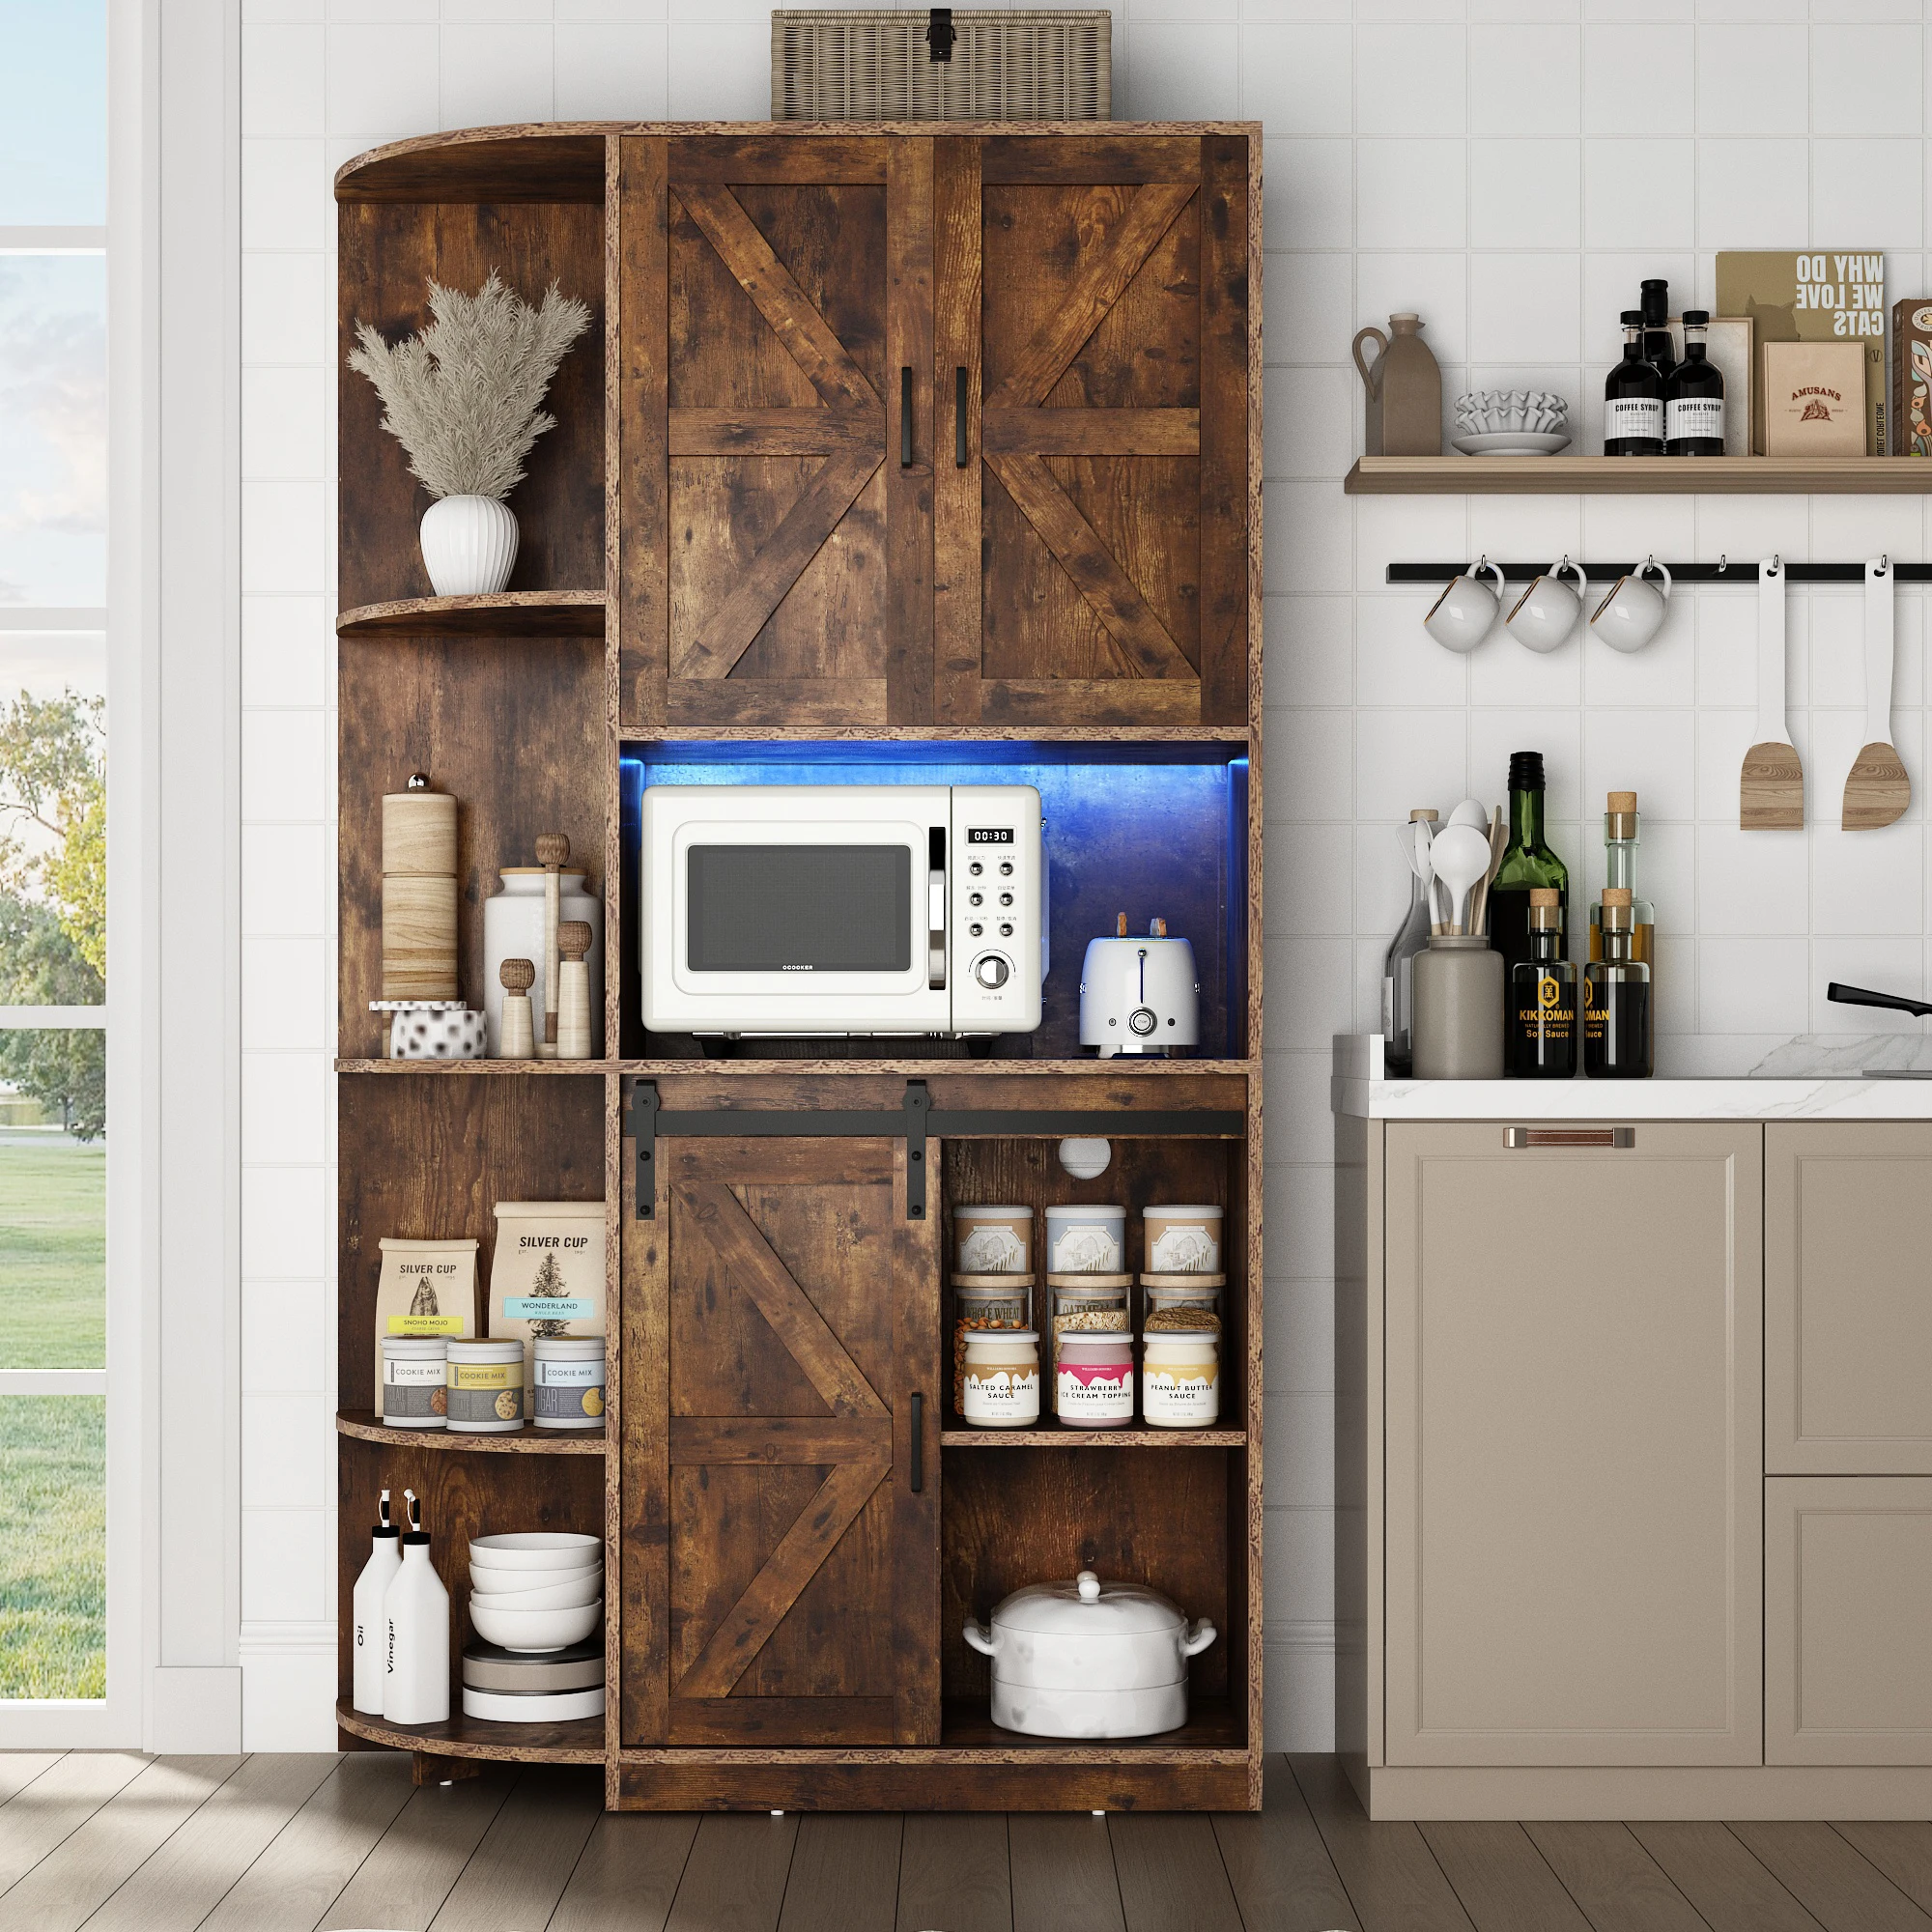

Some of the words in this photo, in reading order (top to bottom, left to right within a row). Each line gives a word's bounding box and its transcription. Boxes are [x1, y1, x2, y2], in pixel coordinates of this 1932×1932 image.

[1791, 386, 1842, 402] AMUSANS
[1615, 403, 1638, 412] COFFEE
[1640, 403, 1659, 412] SYRUP
[1677, 403, 1700, 412] COFFEE
[1703, 403, 1721, 412] SYRUP
[974, 831, 1008, 841] 00:30
[1520, 1009, 1574, 1021] KIKKOMAN
[1526, 1029, 1543, 1039] Soy
[1545, 1029, 1570, 1038] Sauce
[520, 1236, 560, 1248] SILVER
[563, 1236, 588, 1248] CUP
[399, 1264, 434, 1274] SILVER
[436, 1264, 457, 1274] CUP
[387, 1618, 396, 1674] Vinegar
